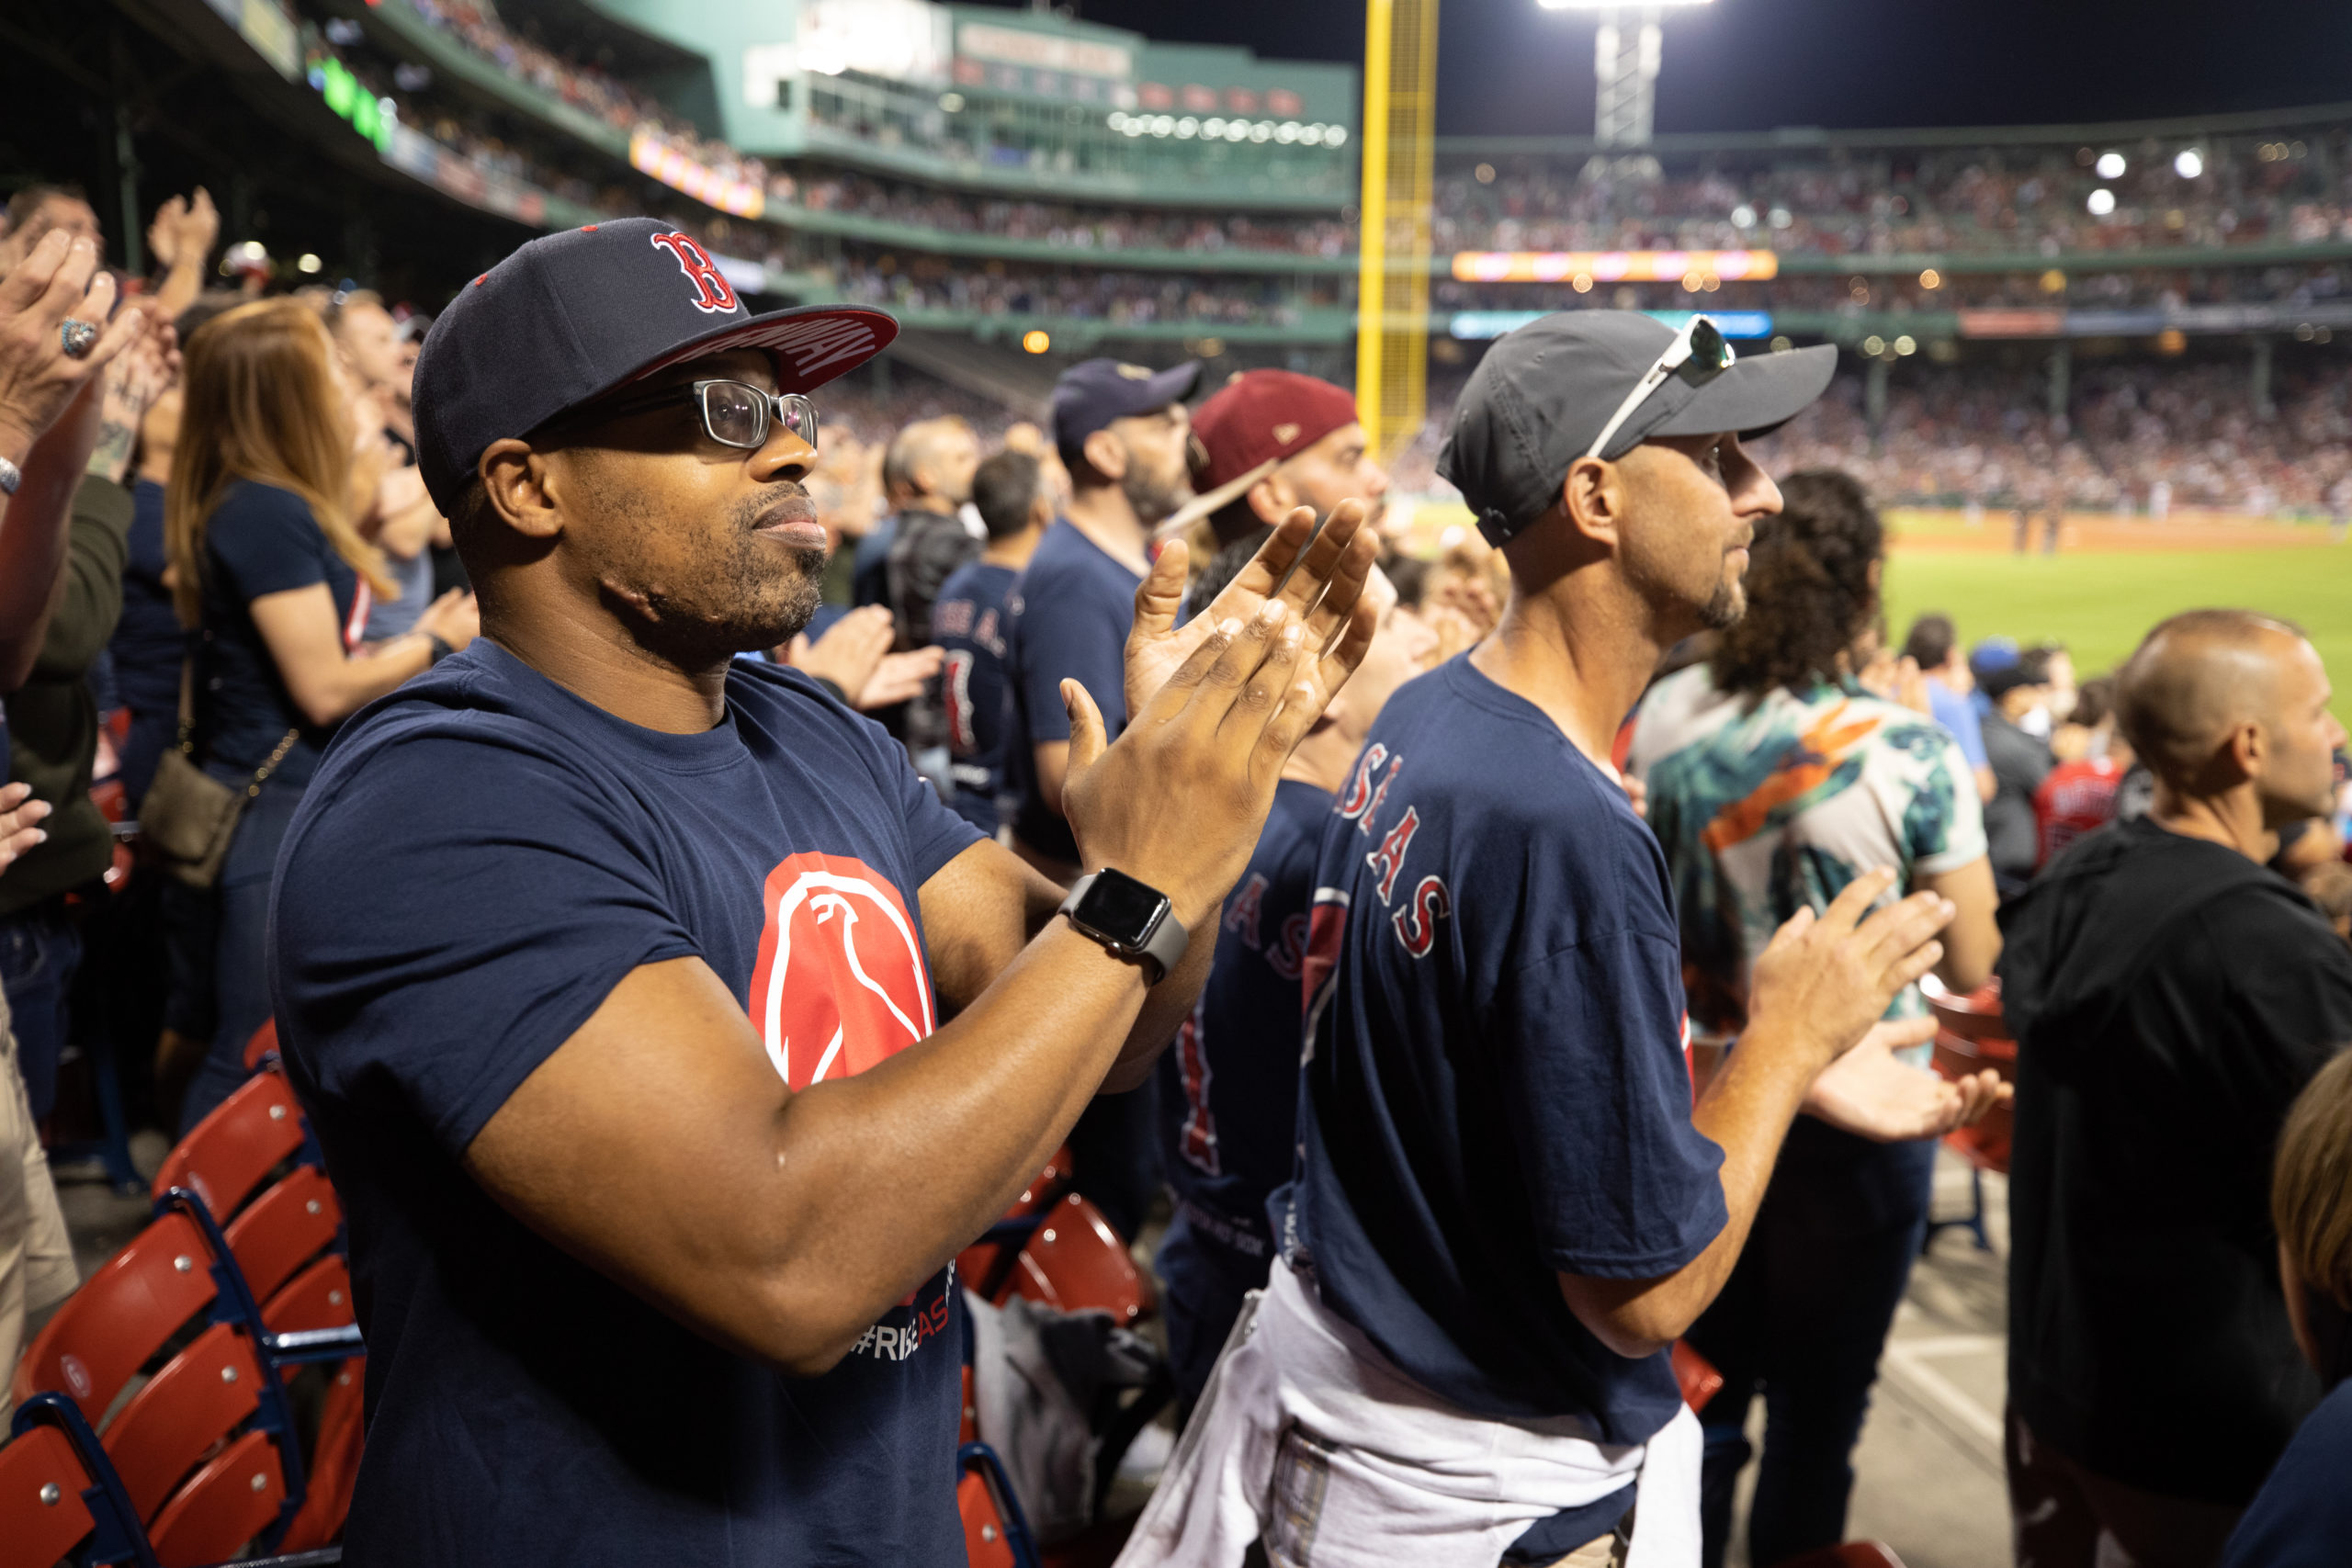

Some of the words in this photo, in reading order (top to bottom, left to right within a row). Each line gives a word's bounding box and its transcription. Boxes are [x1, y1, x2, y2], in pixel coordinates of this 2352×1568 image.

[650, 231, 738, 313] B
[1226, 873, 1309, 980] AS
[1366, 805, 1450, 958] AS
